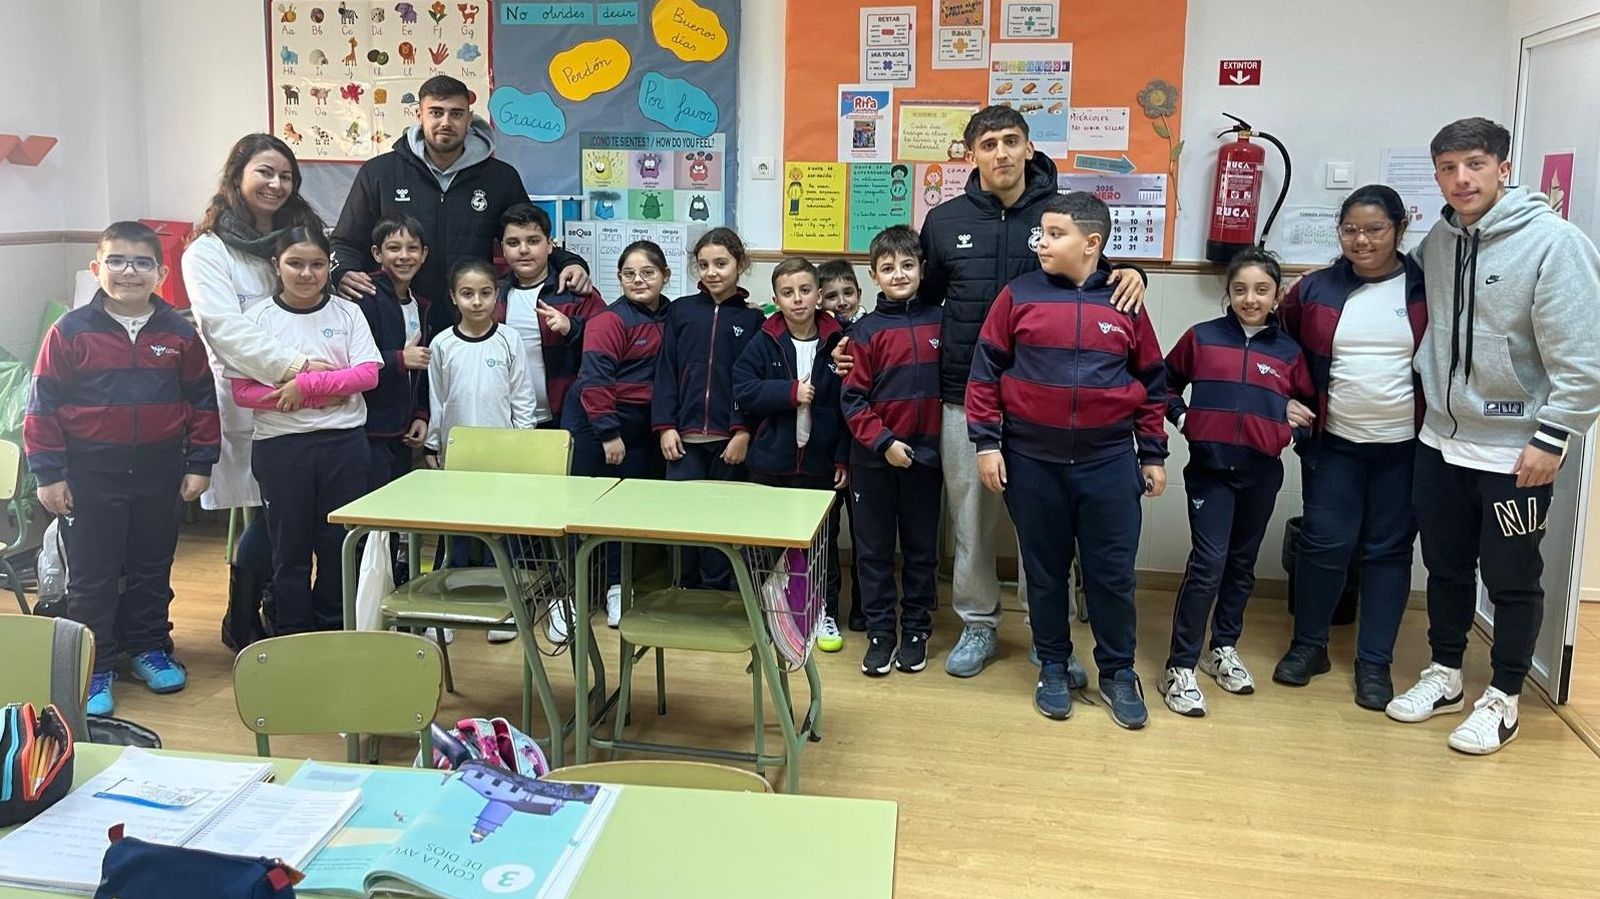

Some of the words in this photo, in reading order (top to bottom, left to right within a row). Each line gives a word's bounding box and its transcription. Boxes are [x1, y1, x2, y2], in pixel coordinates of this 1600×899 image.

[506, 6, 527, 20] No
[542, 6, 584, 20] olvides
[603, 7, 635, 18] decir
[673, 7, 716, 41] Buenos
[282, 26, 295, 35] Aa
[312, 26, 322, 35] Bb
[372, 26, 382, 35] Dd
[402, 26, 412, 35] Ee
[462, 26, 474, 39] Gg
[672, 32, 697, 51] días
[462, 67, 476, 76] Nn
[562, 57, 612, 85] Perdón
[645, 80, 664, 109] Por
[674, 95, 716, 124] favor
[855, 97, 876, 108] Rifa
[500, 101, 562, 133] Gracias
[612, 137, 620, 146] TE
[620, 137, 646, 147] SIENTES
[656, 137, 672, 147] HOW
[672, 137, 682, 148] DO
[682, 137, 696, 148] YOU
[1092, 191, 1121, 200] NERO
[1216, 206, 1249, 218] RUCA
[1494, 496, 1548, 536] NI
[426, 842, 460, 862] DIOS
[423, 853, 440, 867] LA
[466, 858, 483, 871] DE
[442, 864, 475, 881] CON
[498, 871, 520, 887] 3
